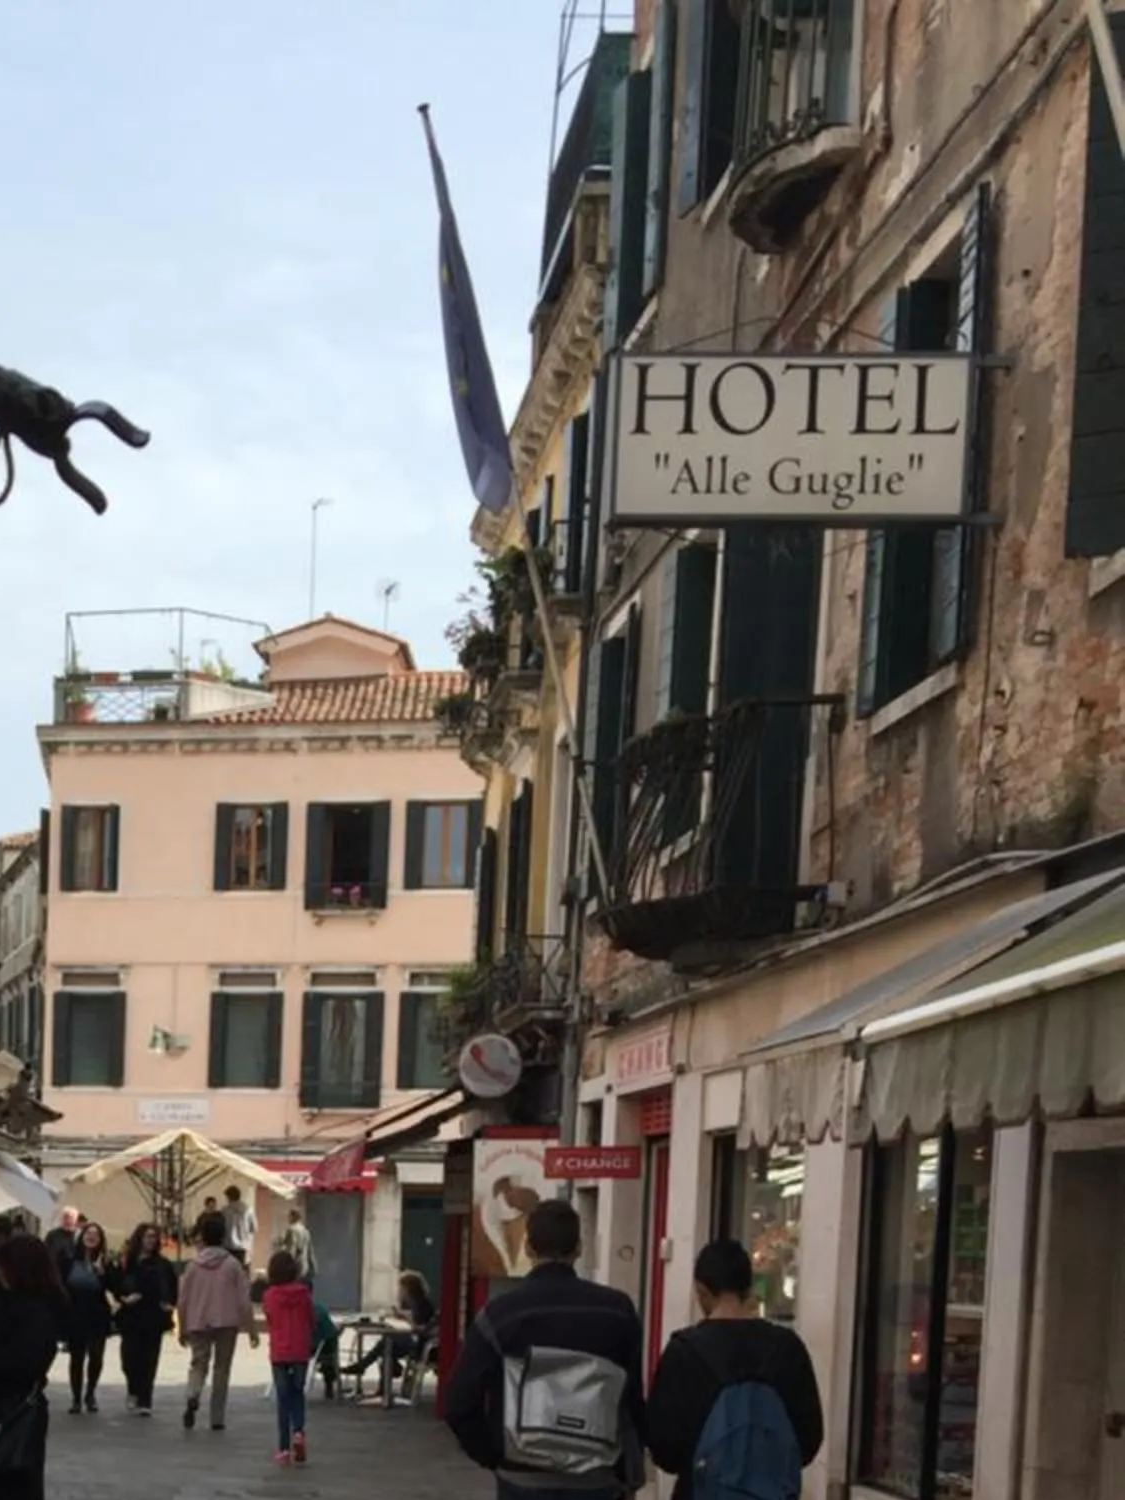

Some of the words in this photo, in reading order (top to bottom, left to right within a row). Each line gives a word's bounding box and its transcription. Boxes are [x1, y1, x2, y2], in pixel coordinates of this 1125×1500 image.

[629, 361, 961, 437] HOTEL
[654, 452, 752, 496] "Alle
[768, 452, 925, 511] Guglie"
[565, 1156, 632, 1170] CHANGE
